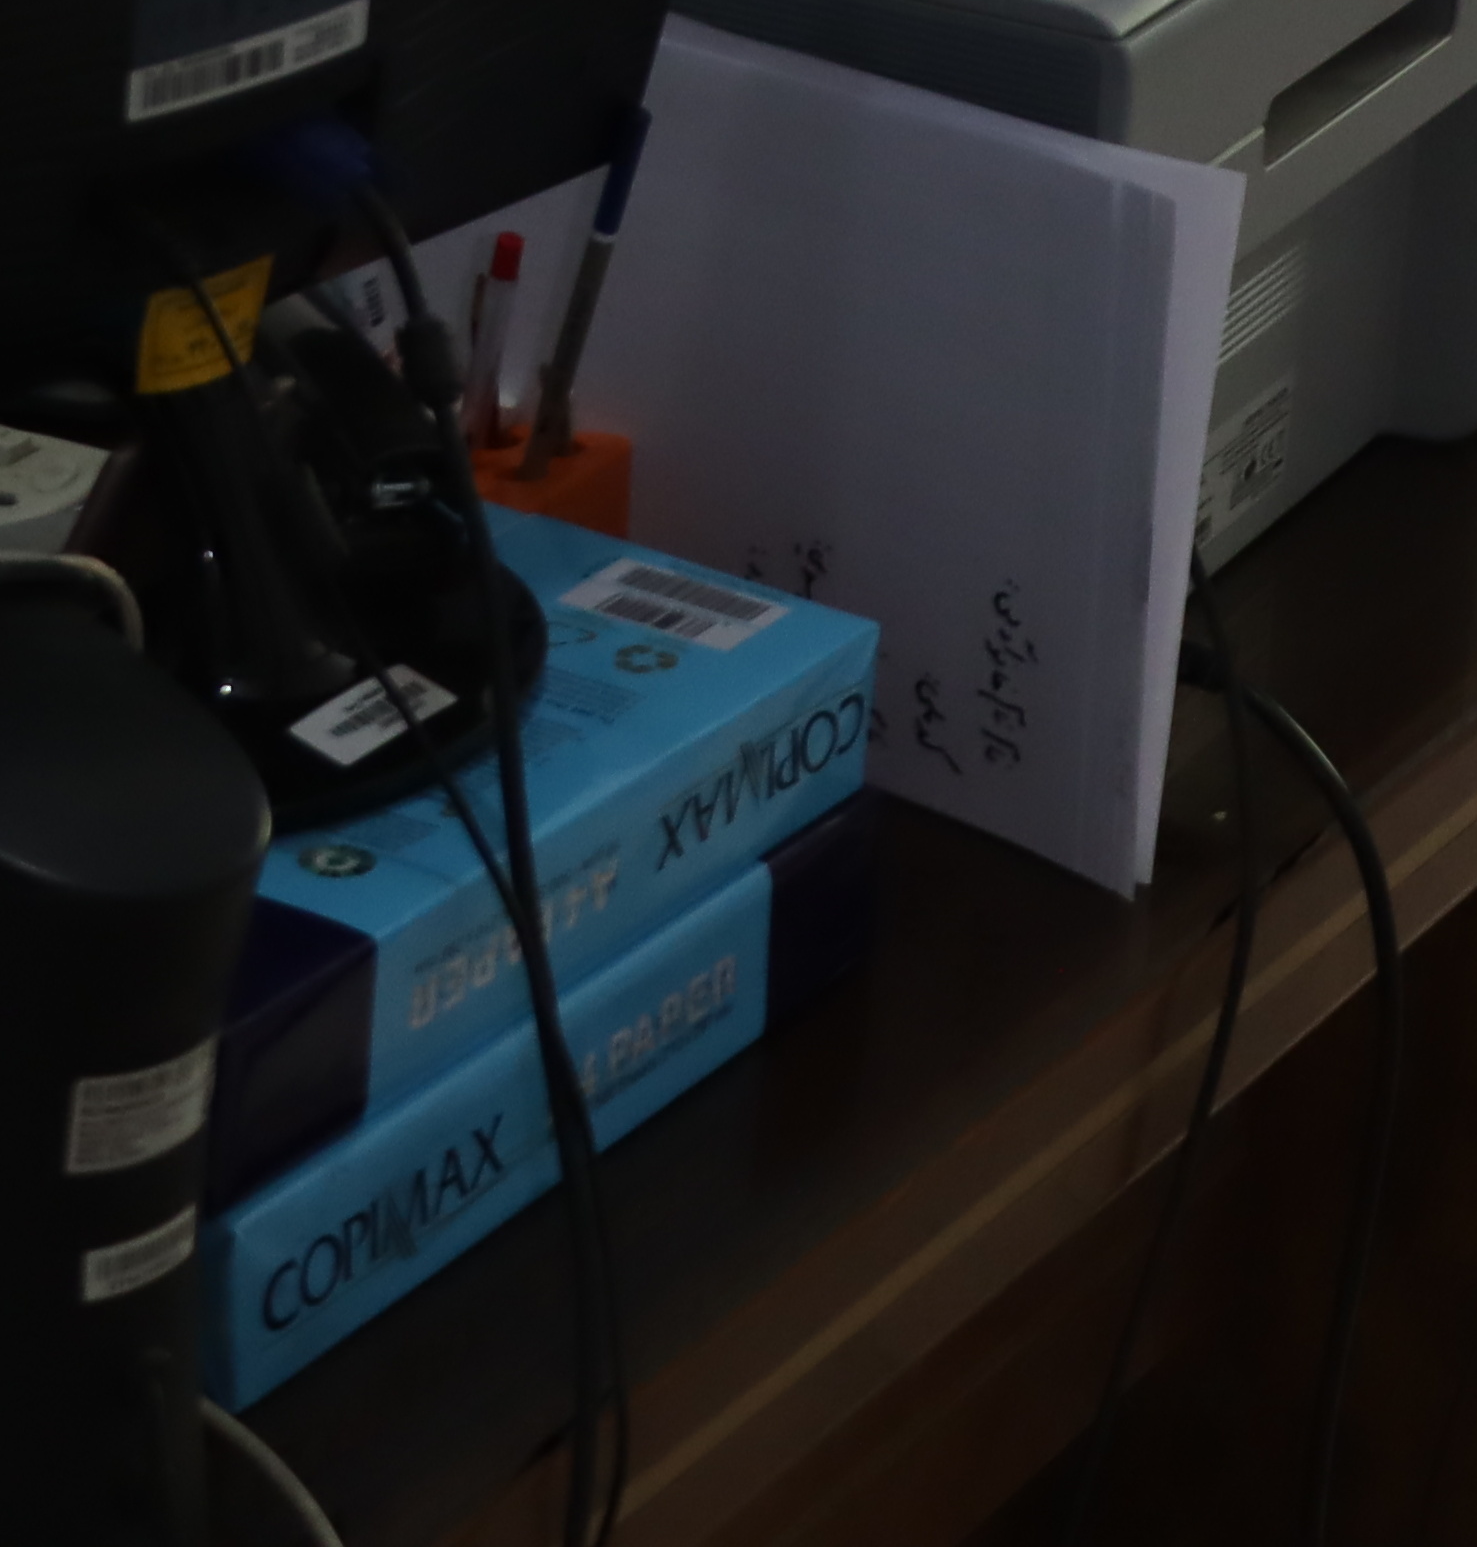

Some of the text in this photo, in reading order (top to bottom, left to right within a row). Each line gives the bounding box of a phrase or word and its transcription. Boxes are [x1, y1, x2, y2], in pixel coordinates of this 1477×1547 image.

[657, 692, 866, 872] COPIMAX
[607, 956, 738, 1082] PAPER
[262, 1112, 504, 1331] COPIMAX
